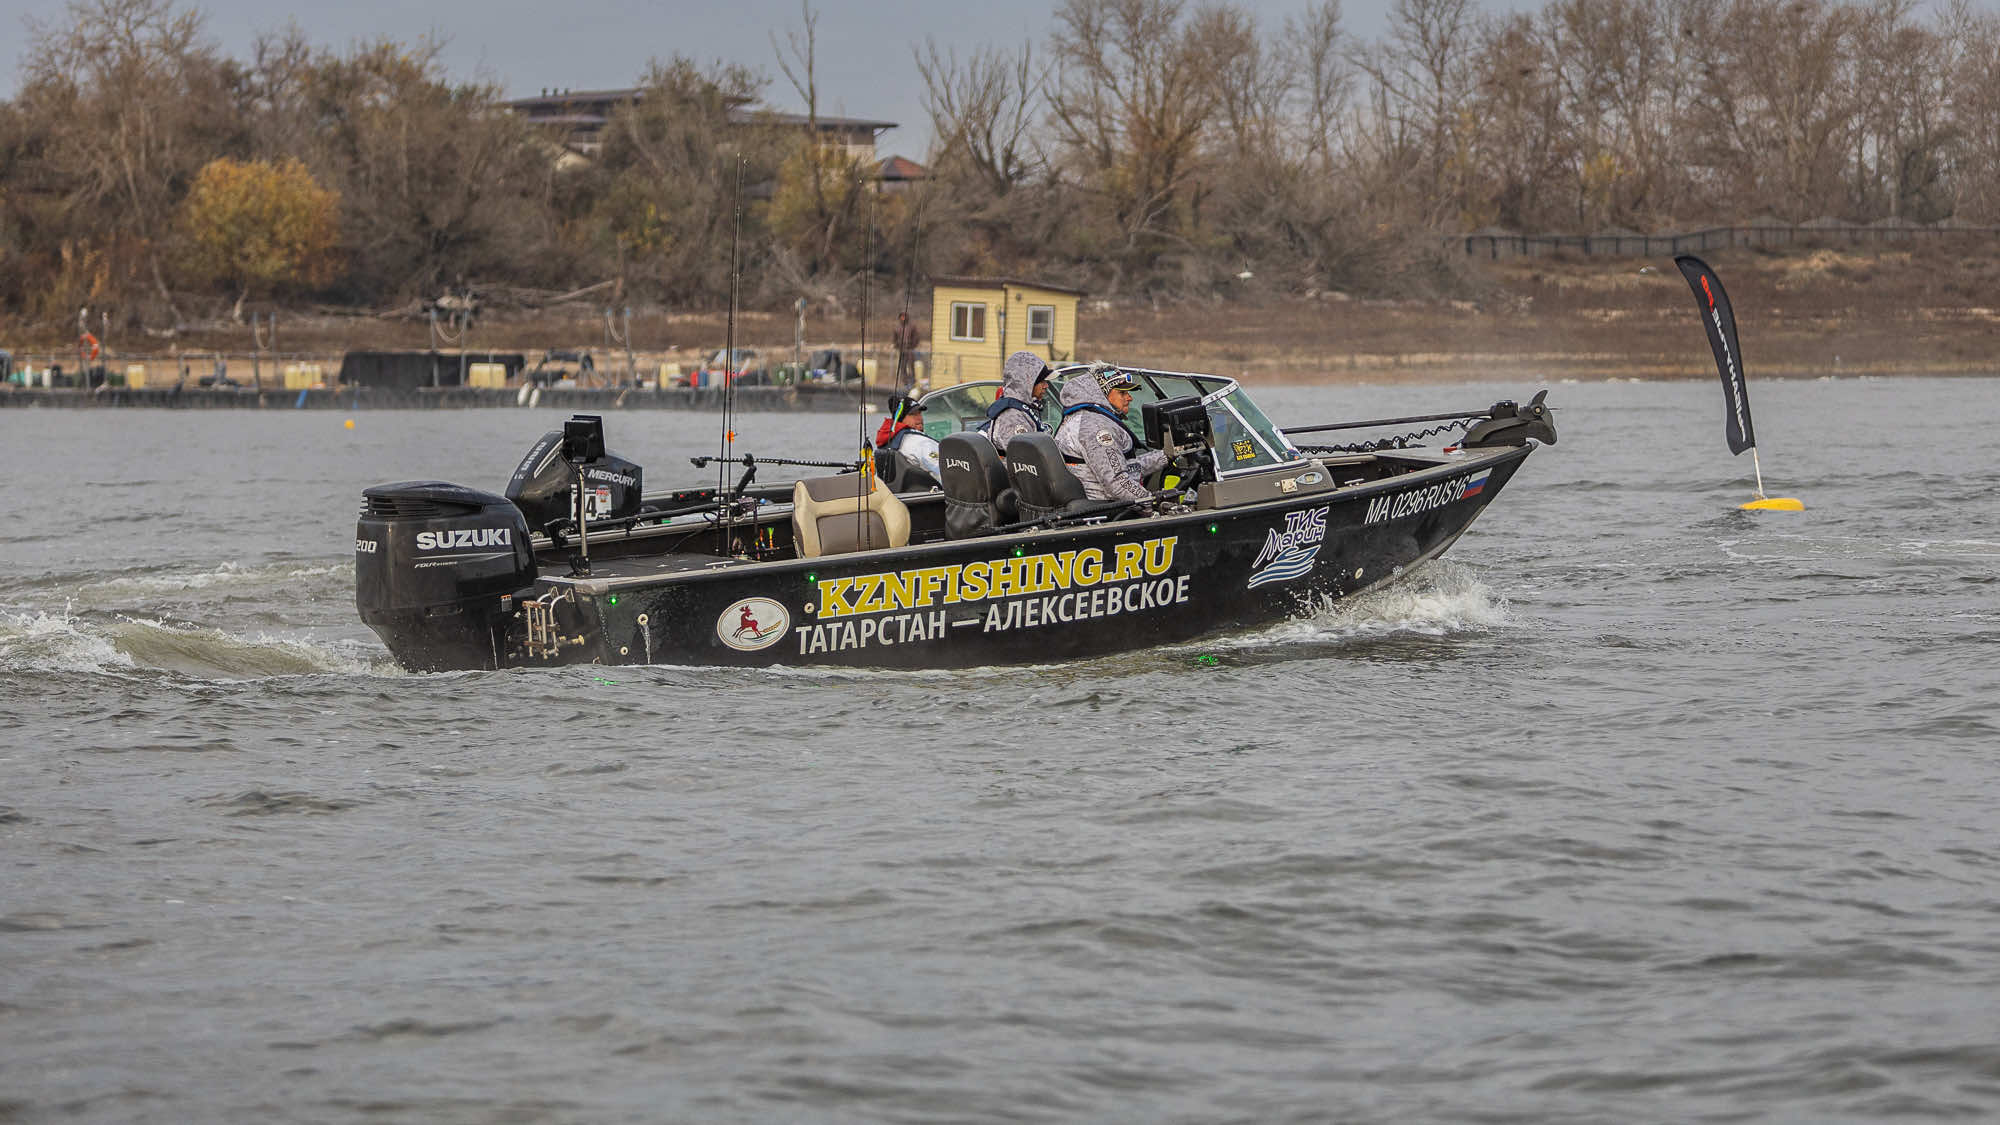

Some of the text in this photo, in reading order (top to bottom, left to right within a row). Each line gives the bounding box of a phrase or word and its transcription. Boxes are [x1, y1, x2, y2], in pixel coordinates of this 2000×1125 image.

[945, 458, 971, 472] LUND
[1012, 462, 1038, 476] LUND
[588, 468, 637, 486] MERCURY
[1285, 506, 1330, 533] ТИС
[356, 539, 377, 553] 200
[416, 528, 512, 550] SUZUKI
[816, 536, 1178, 619] KZNFISHING.RU
[795, 610, 946, 655] ТАТАРСТАН
[983, 575, 1190, 633] АЛЕКСЕЕВСКОЕ
